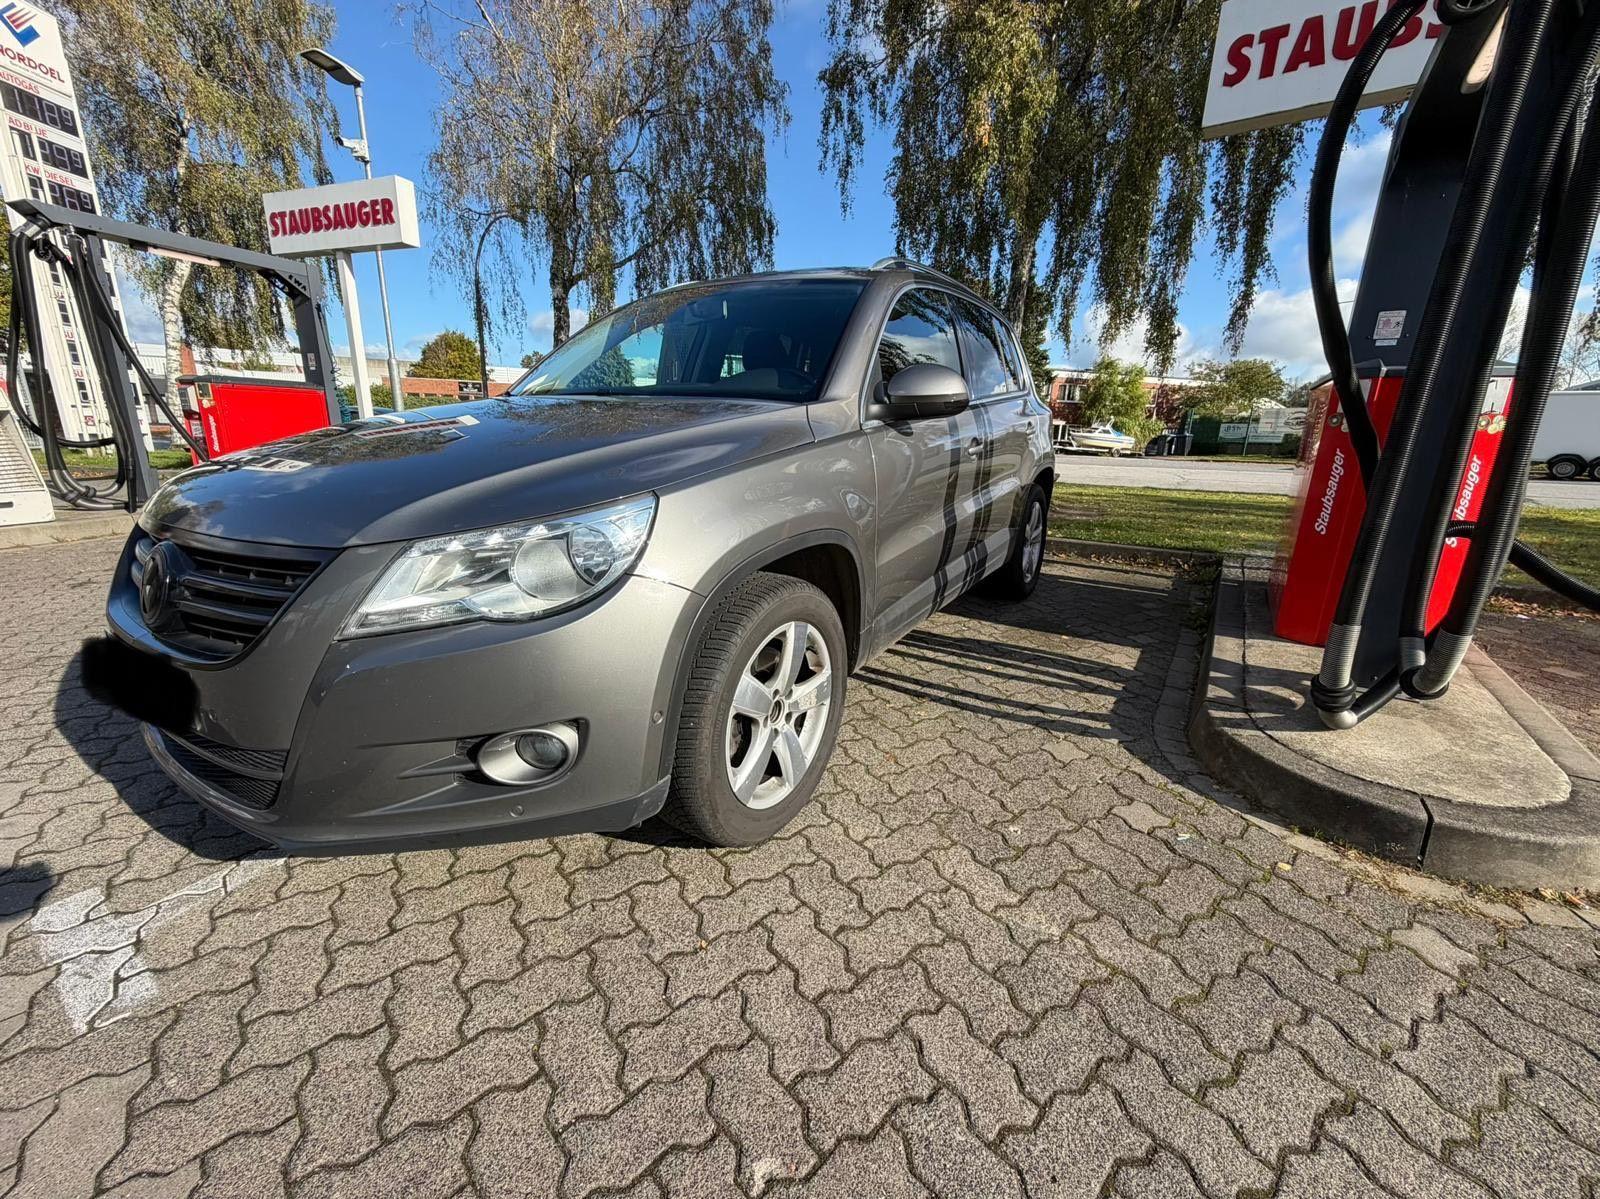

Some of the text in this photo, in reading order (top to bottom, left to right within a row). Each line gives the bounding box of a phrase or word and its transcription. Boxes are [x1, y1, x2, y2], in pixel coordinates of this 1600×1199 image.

[269, 198, 395, 237] STAUBSAUGER
[1314, 447, 1345, 535] Staubsauger
[1445, 454, 1482, 548] Sbsauger
